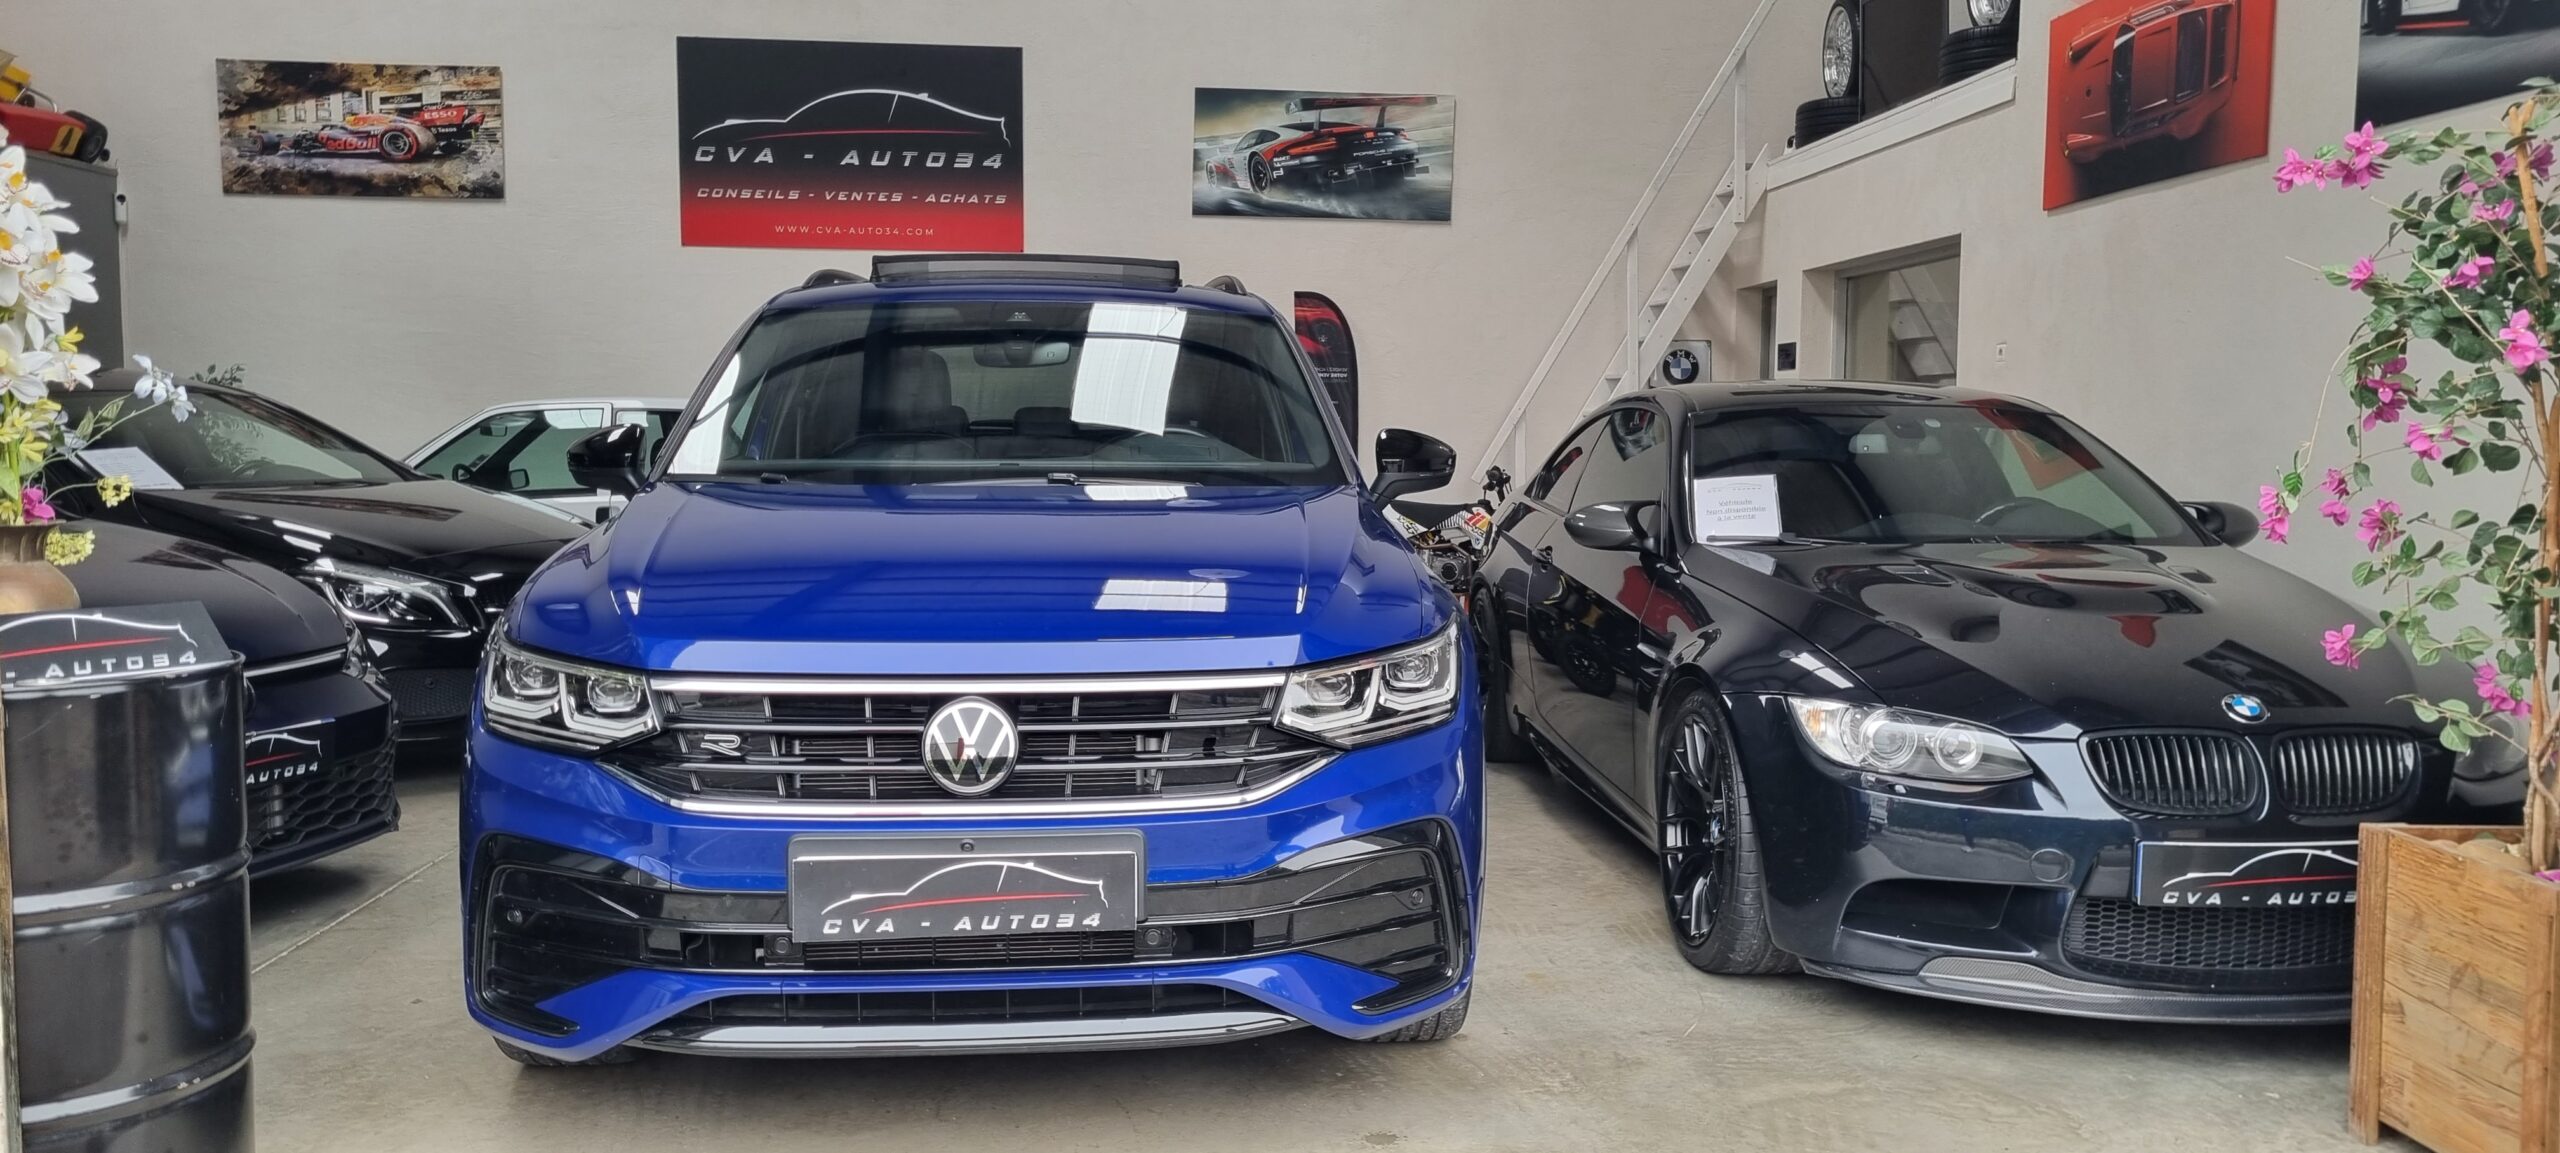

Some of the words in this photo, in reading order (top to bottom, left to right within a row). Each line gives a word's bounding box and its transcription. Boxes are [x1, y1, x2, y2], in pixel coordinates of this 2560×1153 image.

[424, 111, 457, 120] ESSO
[694, 146, 774, 164] CVA
[840, 149, 1003, 169] AUTO34
[697, 188, 800, 200] CONSEILS
[825, 191, 903, 202] VENTES
[925, 193, 1007, 204] ACHATS
[775, 225, 934, 236] WWW.CVA-AUTO34.COM
[1666, 350, 1697, 364] BMW
[45, 651, 197, 678] AUTO34
[246, 762, 318, 784] AUTO34
[2162, 891, 2222, 905] CVA
[2267, 891, 2357, 905] AUTO3
[822, 918, 895, 935] CVA
[953, 912, 1101, 932] AUTO34
